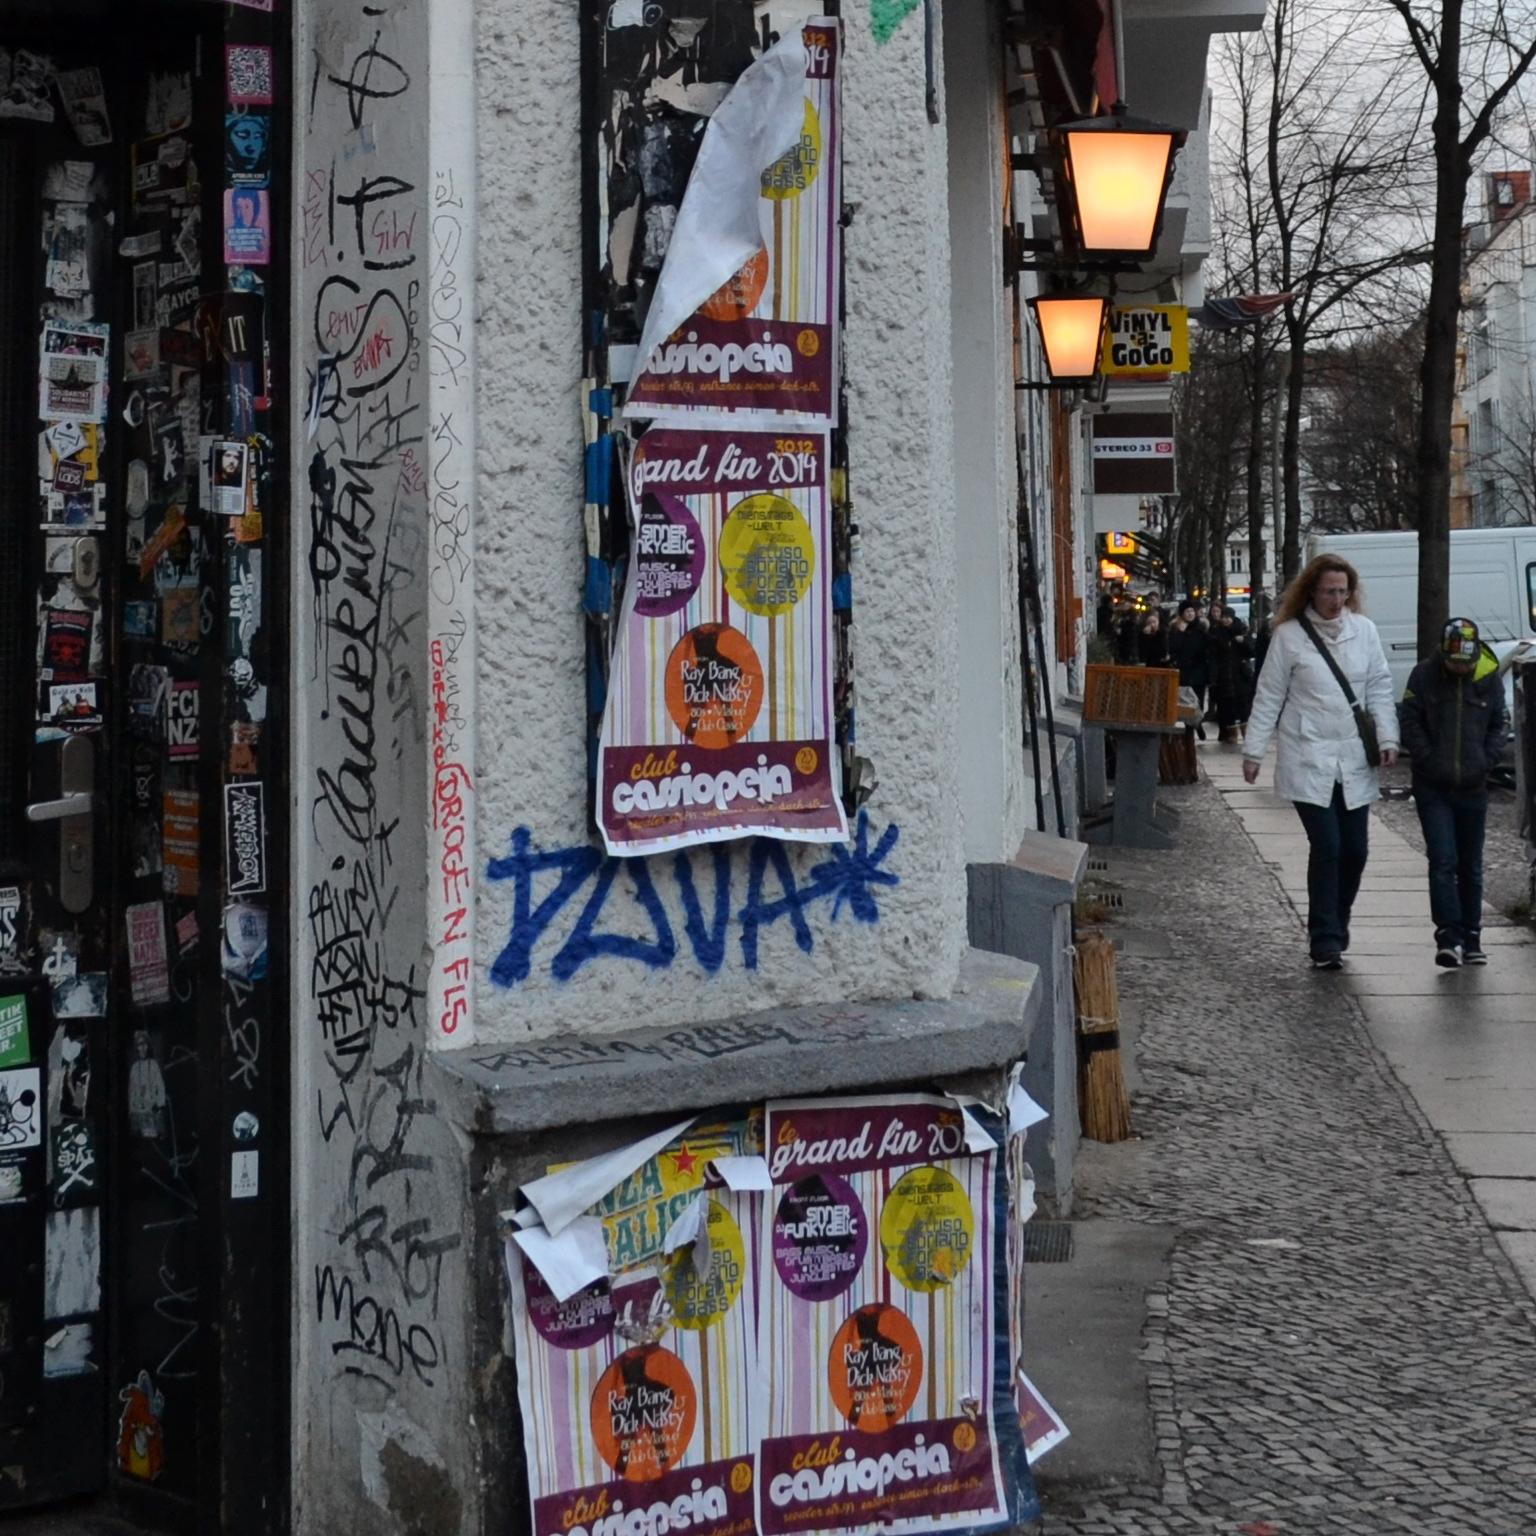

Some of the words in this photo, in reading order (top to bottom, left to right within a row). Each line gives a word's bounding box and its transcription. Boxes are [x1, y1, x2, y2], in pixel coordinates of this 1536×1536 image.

[1112, 343, 1174, 366] GoGo
[1094, 443, 1138, 453] STEREO
[1138, 443, 1152, 453] 33
[715, 443, 762, 483] fin
[767, 452, 817, 484] 2014
[680, 660, 705, 685] Ray
[709, 661, 741, 687] Bang
[684, 684, 709, 703] Dick
[631, 749, 678, 780] club
[777, 1120, 800, 1145] le
[770, 1122, 873, 1179] grand
[877, 1118, 923, 1160] fin
[806, 1205, 851, 1222] SINNER
[843, 1343, 868, 1368] Ray
[846, 1367, 874, 1388] Dick
[792, 1436, 842, 1470] club
[769, 1433, 952, 1506] cassiopeia
